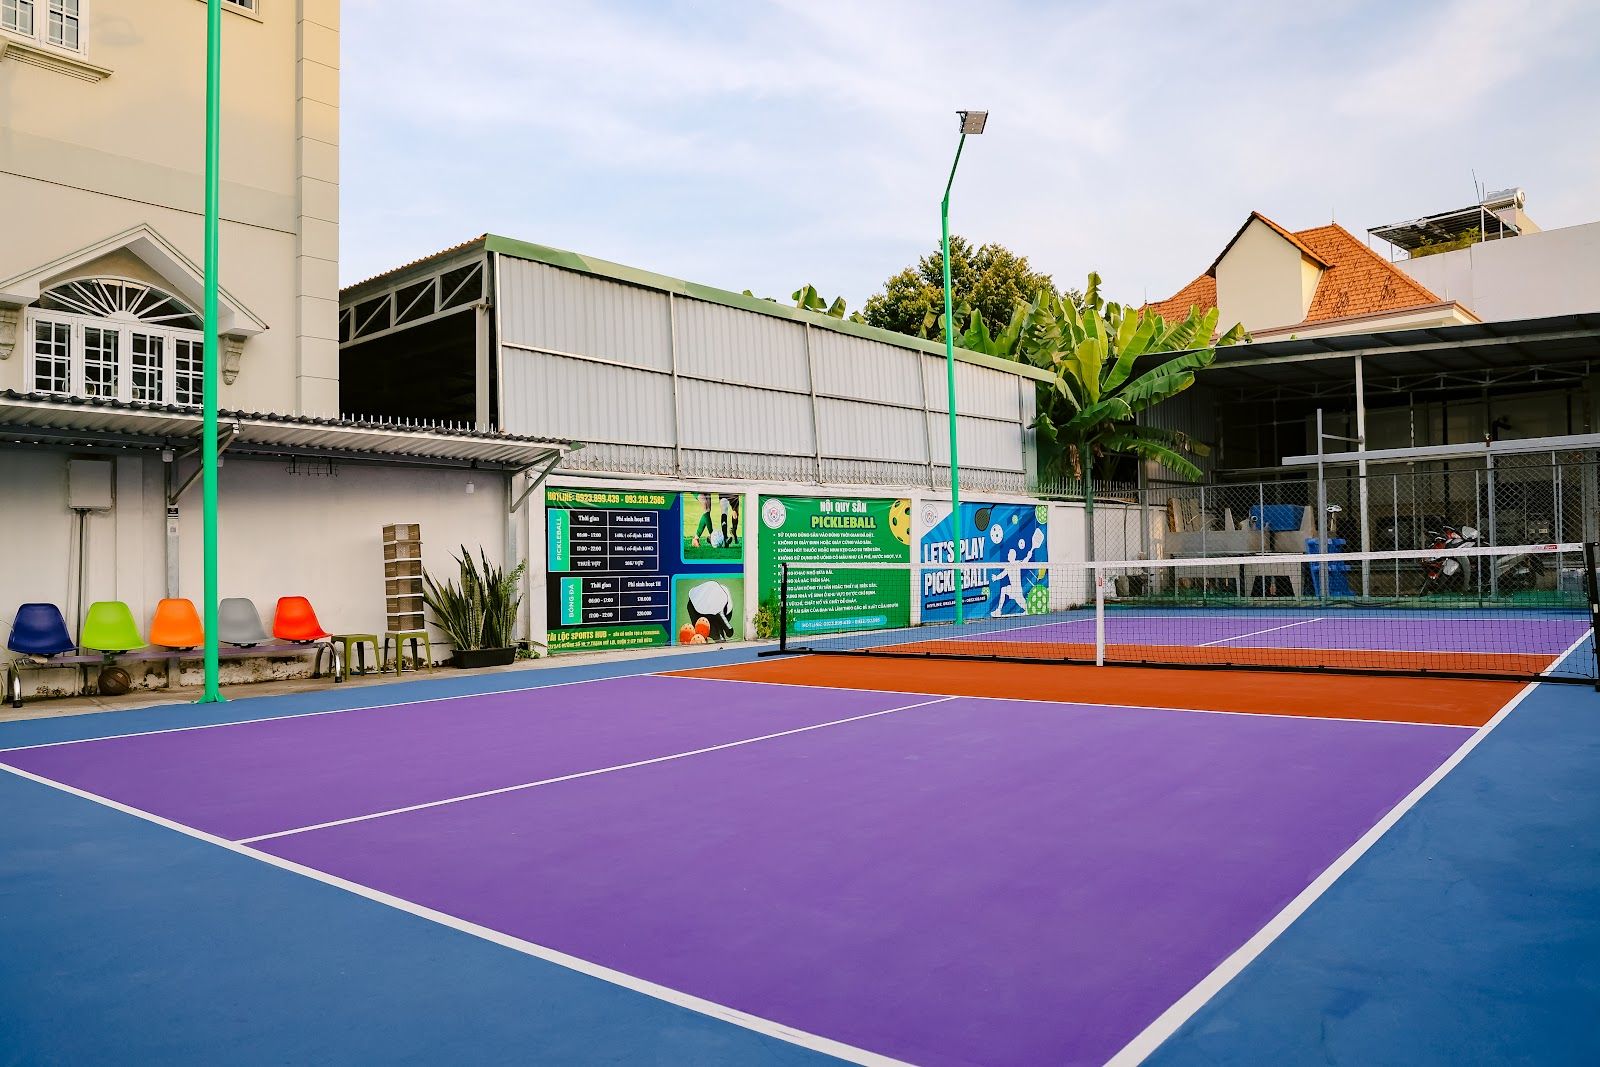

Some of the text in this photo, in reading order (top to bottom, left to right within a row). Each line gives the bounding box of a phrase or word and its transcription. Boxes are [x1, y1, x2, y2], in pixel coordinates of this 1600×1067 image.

[820, 499, 867, 514] NỘI QUY SÂN
[812, 516, 876, 528] PICKLEBALL
[924, 537, 985, 563] LET'S PLAY
[558, 632, 570, 642] LỘC
[571, 631, 594, 640] SPORTS
